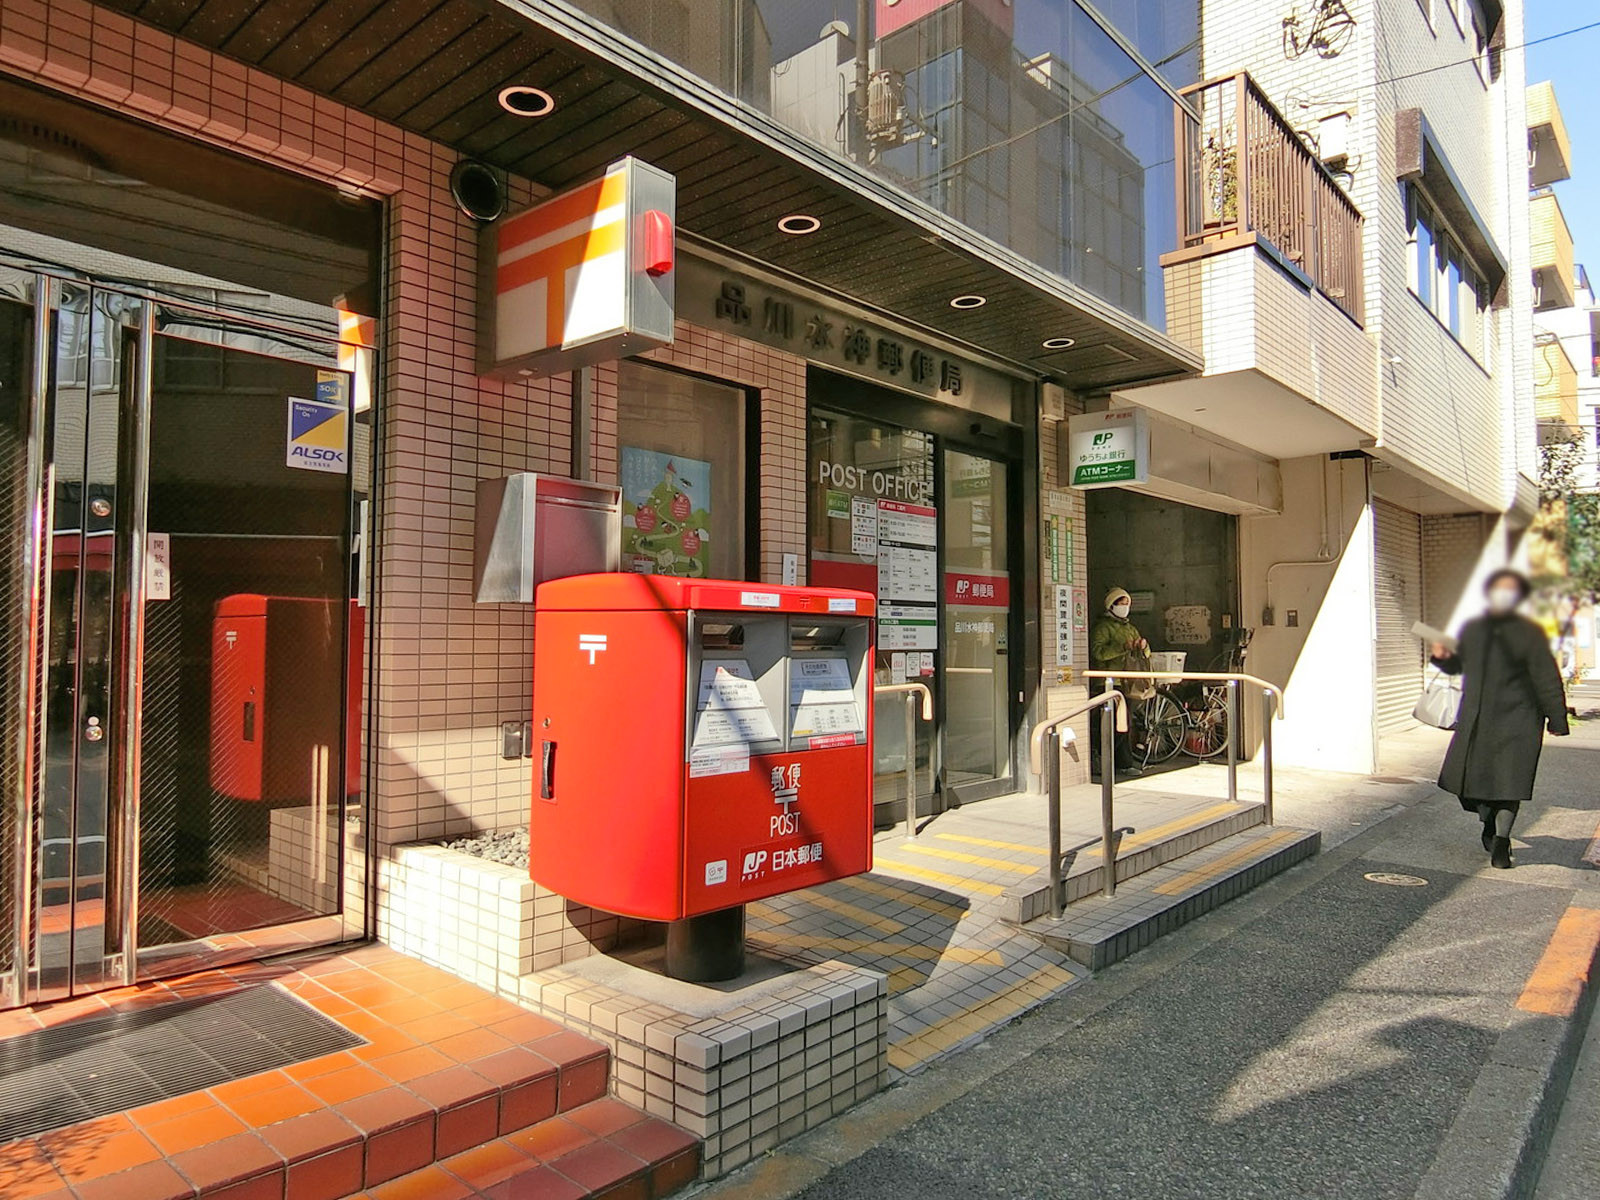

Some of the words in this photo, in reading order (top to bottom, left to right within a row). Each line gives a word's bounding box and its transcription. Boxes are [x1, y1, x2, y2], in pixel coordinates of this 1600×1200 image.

[715, 281, 961, 396] 品川水神郵便局
[295, 404, 318, 413] Security
[291, 446, 344, 462] ALSOK
[1079, 449, 1126, 463] ゆうちょ銀行
[1080, 464, 1130, 476] ATMコーナー
[819, 460, 867, 491] POST
[872, 471, 929, 504] OFFICE
[972, 583, 994, 598] 郵便局
[770, 763, 801, 791] 郵便
[770, 812, 801, 838] POST
[743, 850, 768, 874] JP
[772, 842, 823, 871] 日本郵便
[741, 870, 766, 882] POST
